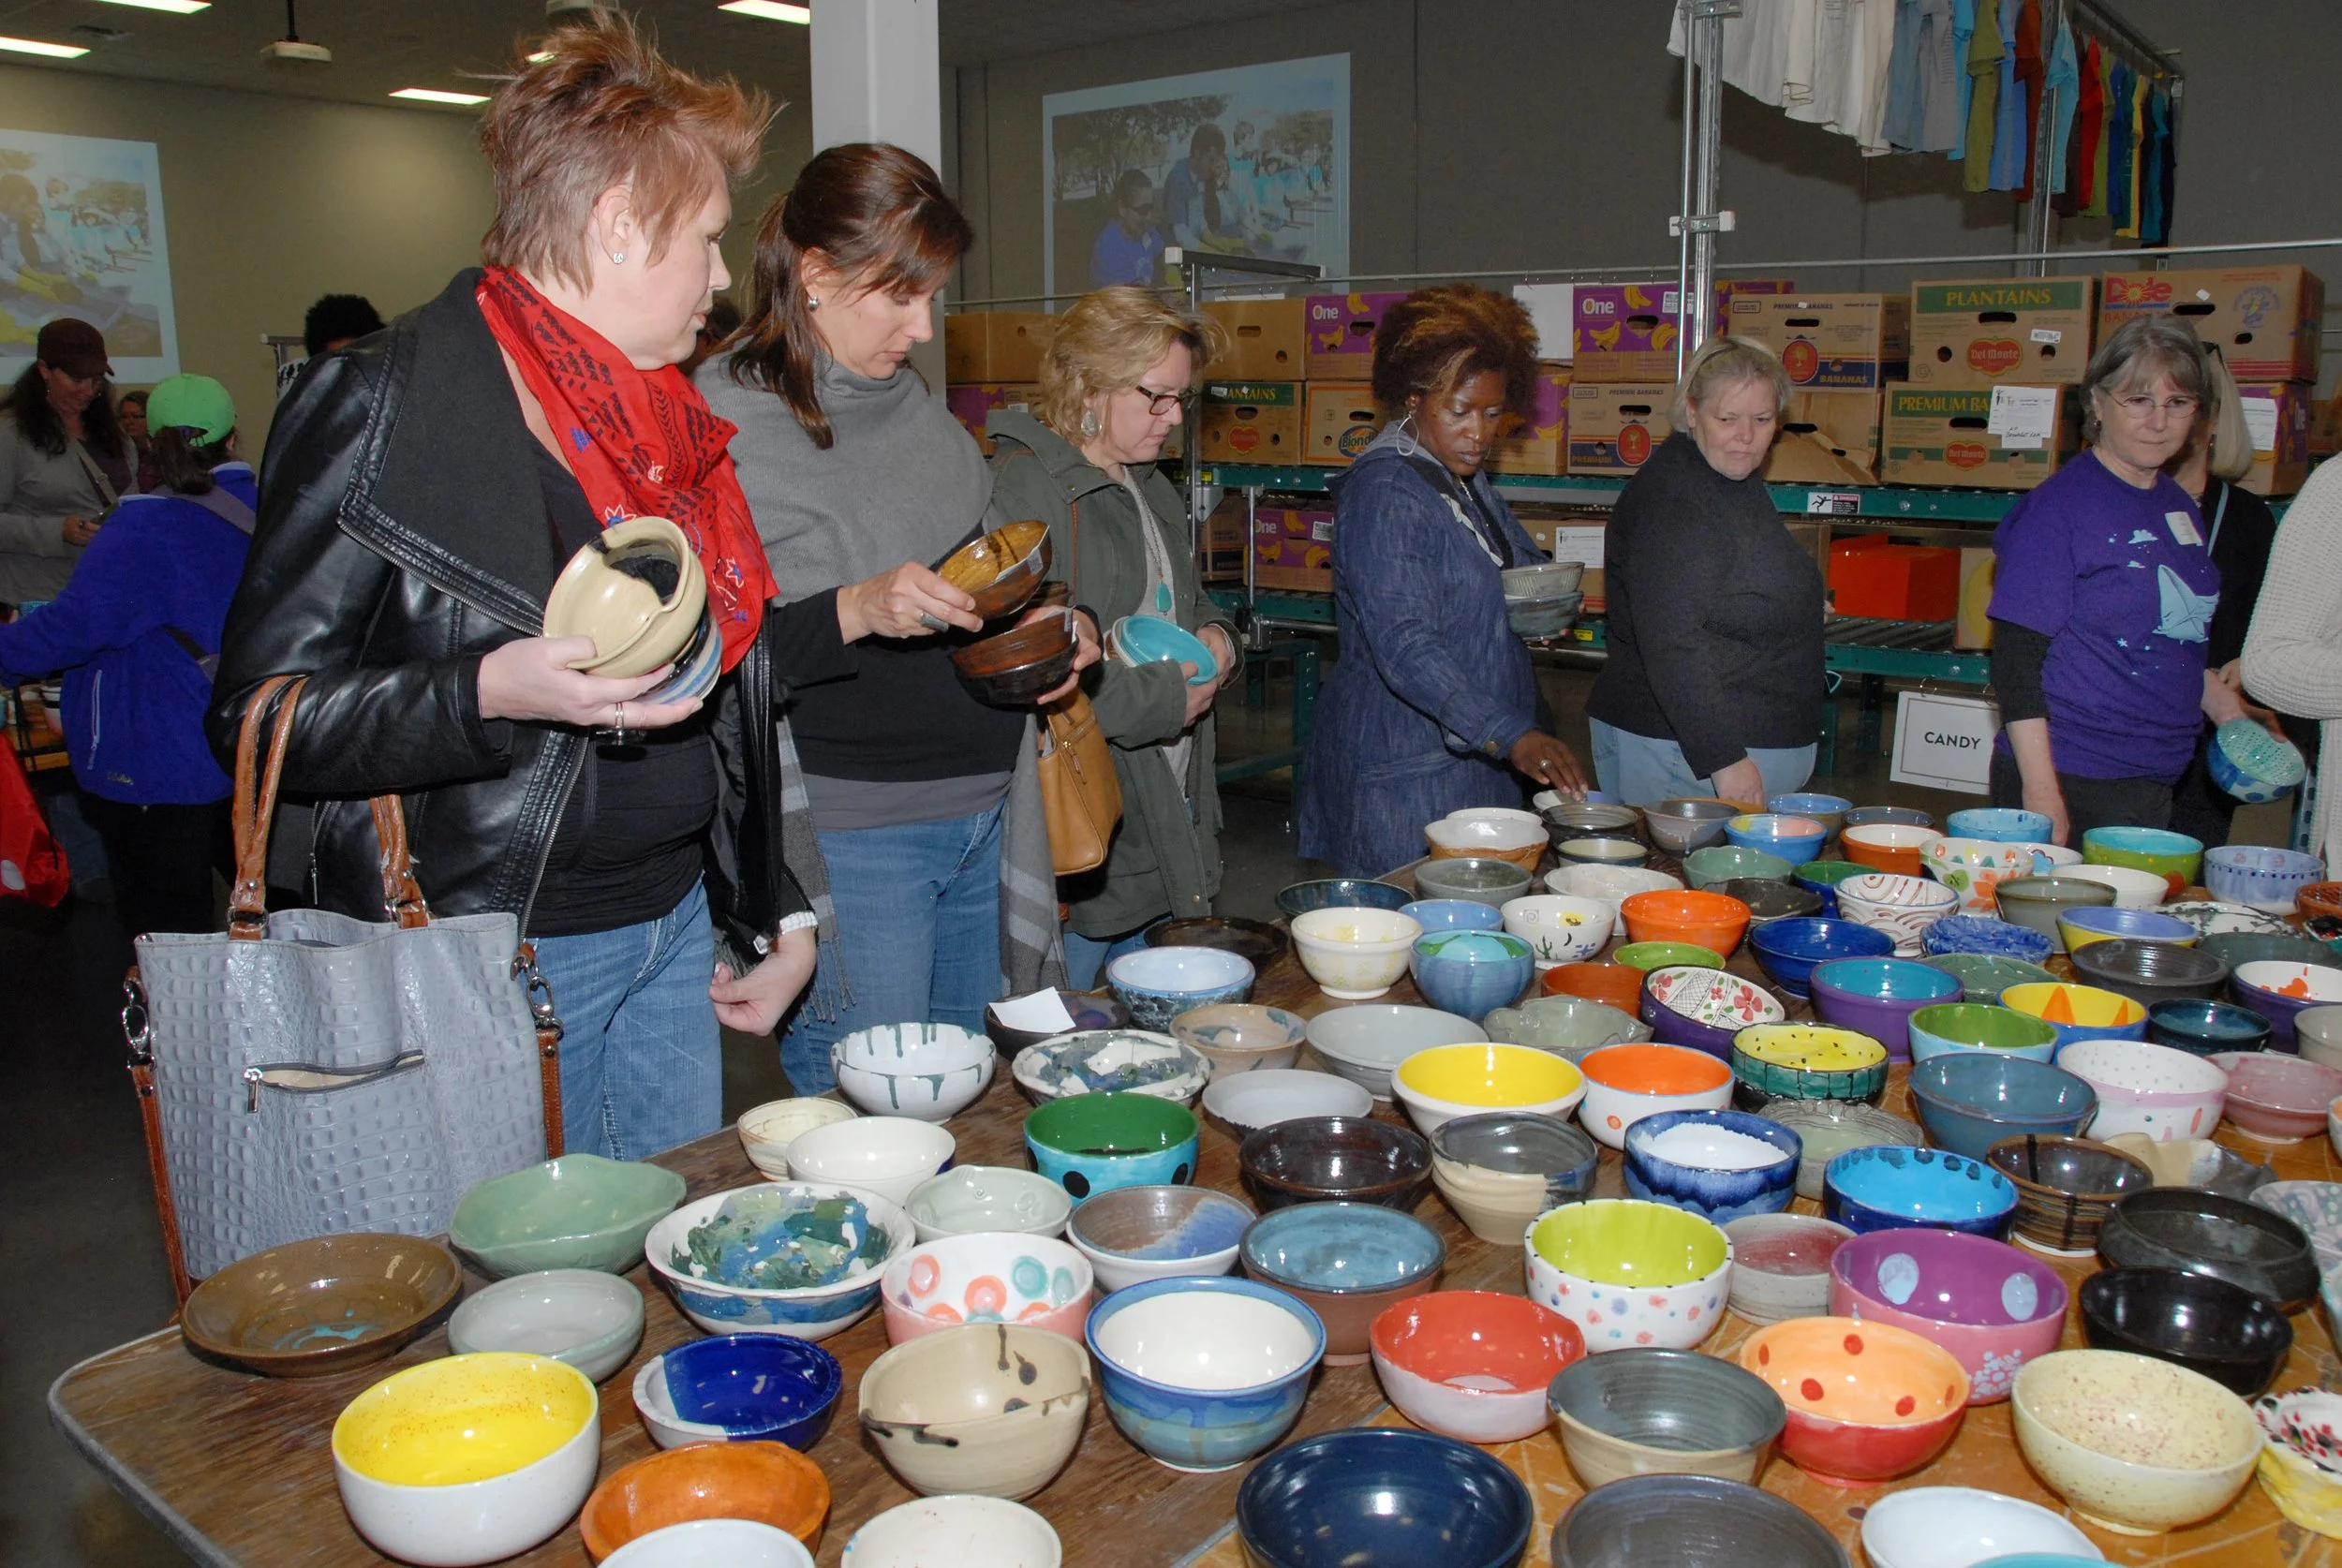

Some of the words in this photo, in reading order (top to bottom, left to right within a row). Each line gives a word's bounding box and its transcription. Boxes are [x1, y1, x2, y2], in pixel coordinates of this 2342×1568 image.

[1946, 288, 2053, 307] PLANTAINS
[1312, 304, 1339, 320] One
[1582, 298, 1615, 315] One
[1970, 348, 1984, 360] Del
[1987, 348, 2019, 360] Monte
[1819, 374, 1868, 384] BANANAS
[1899, 395, 1967, 412] PREMIUM
[1572, 455, 1612, 464] PREMIUM
[1254, 518, 1277, 534] One
[1924, 732, 1981, 750] CANDY
